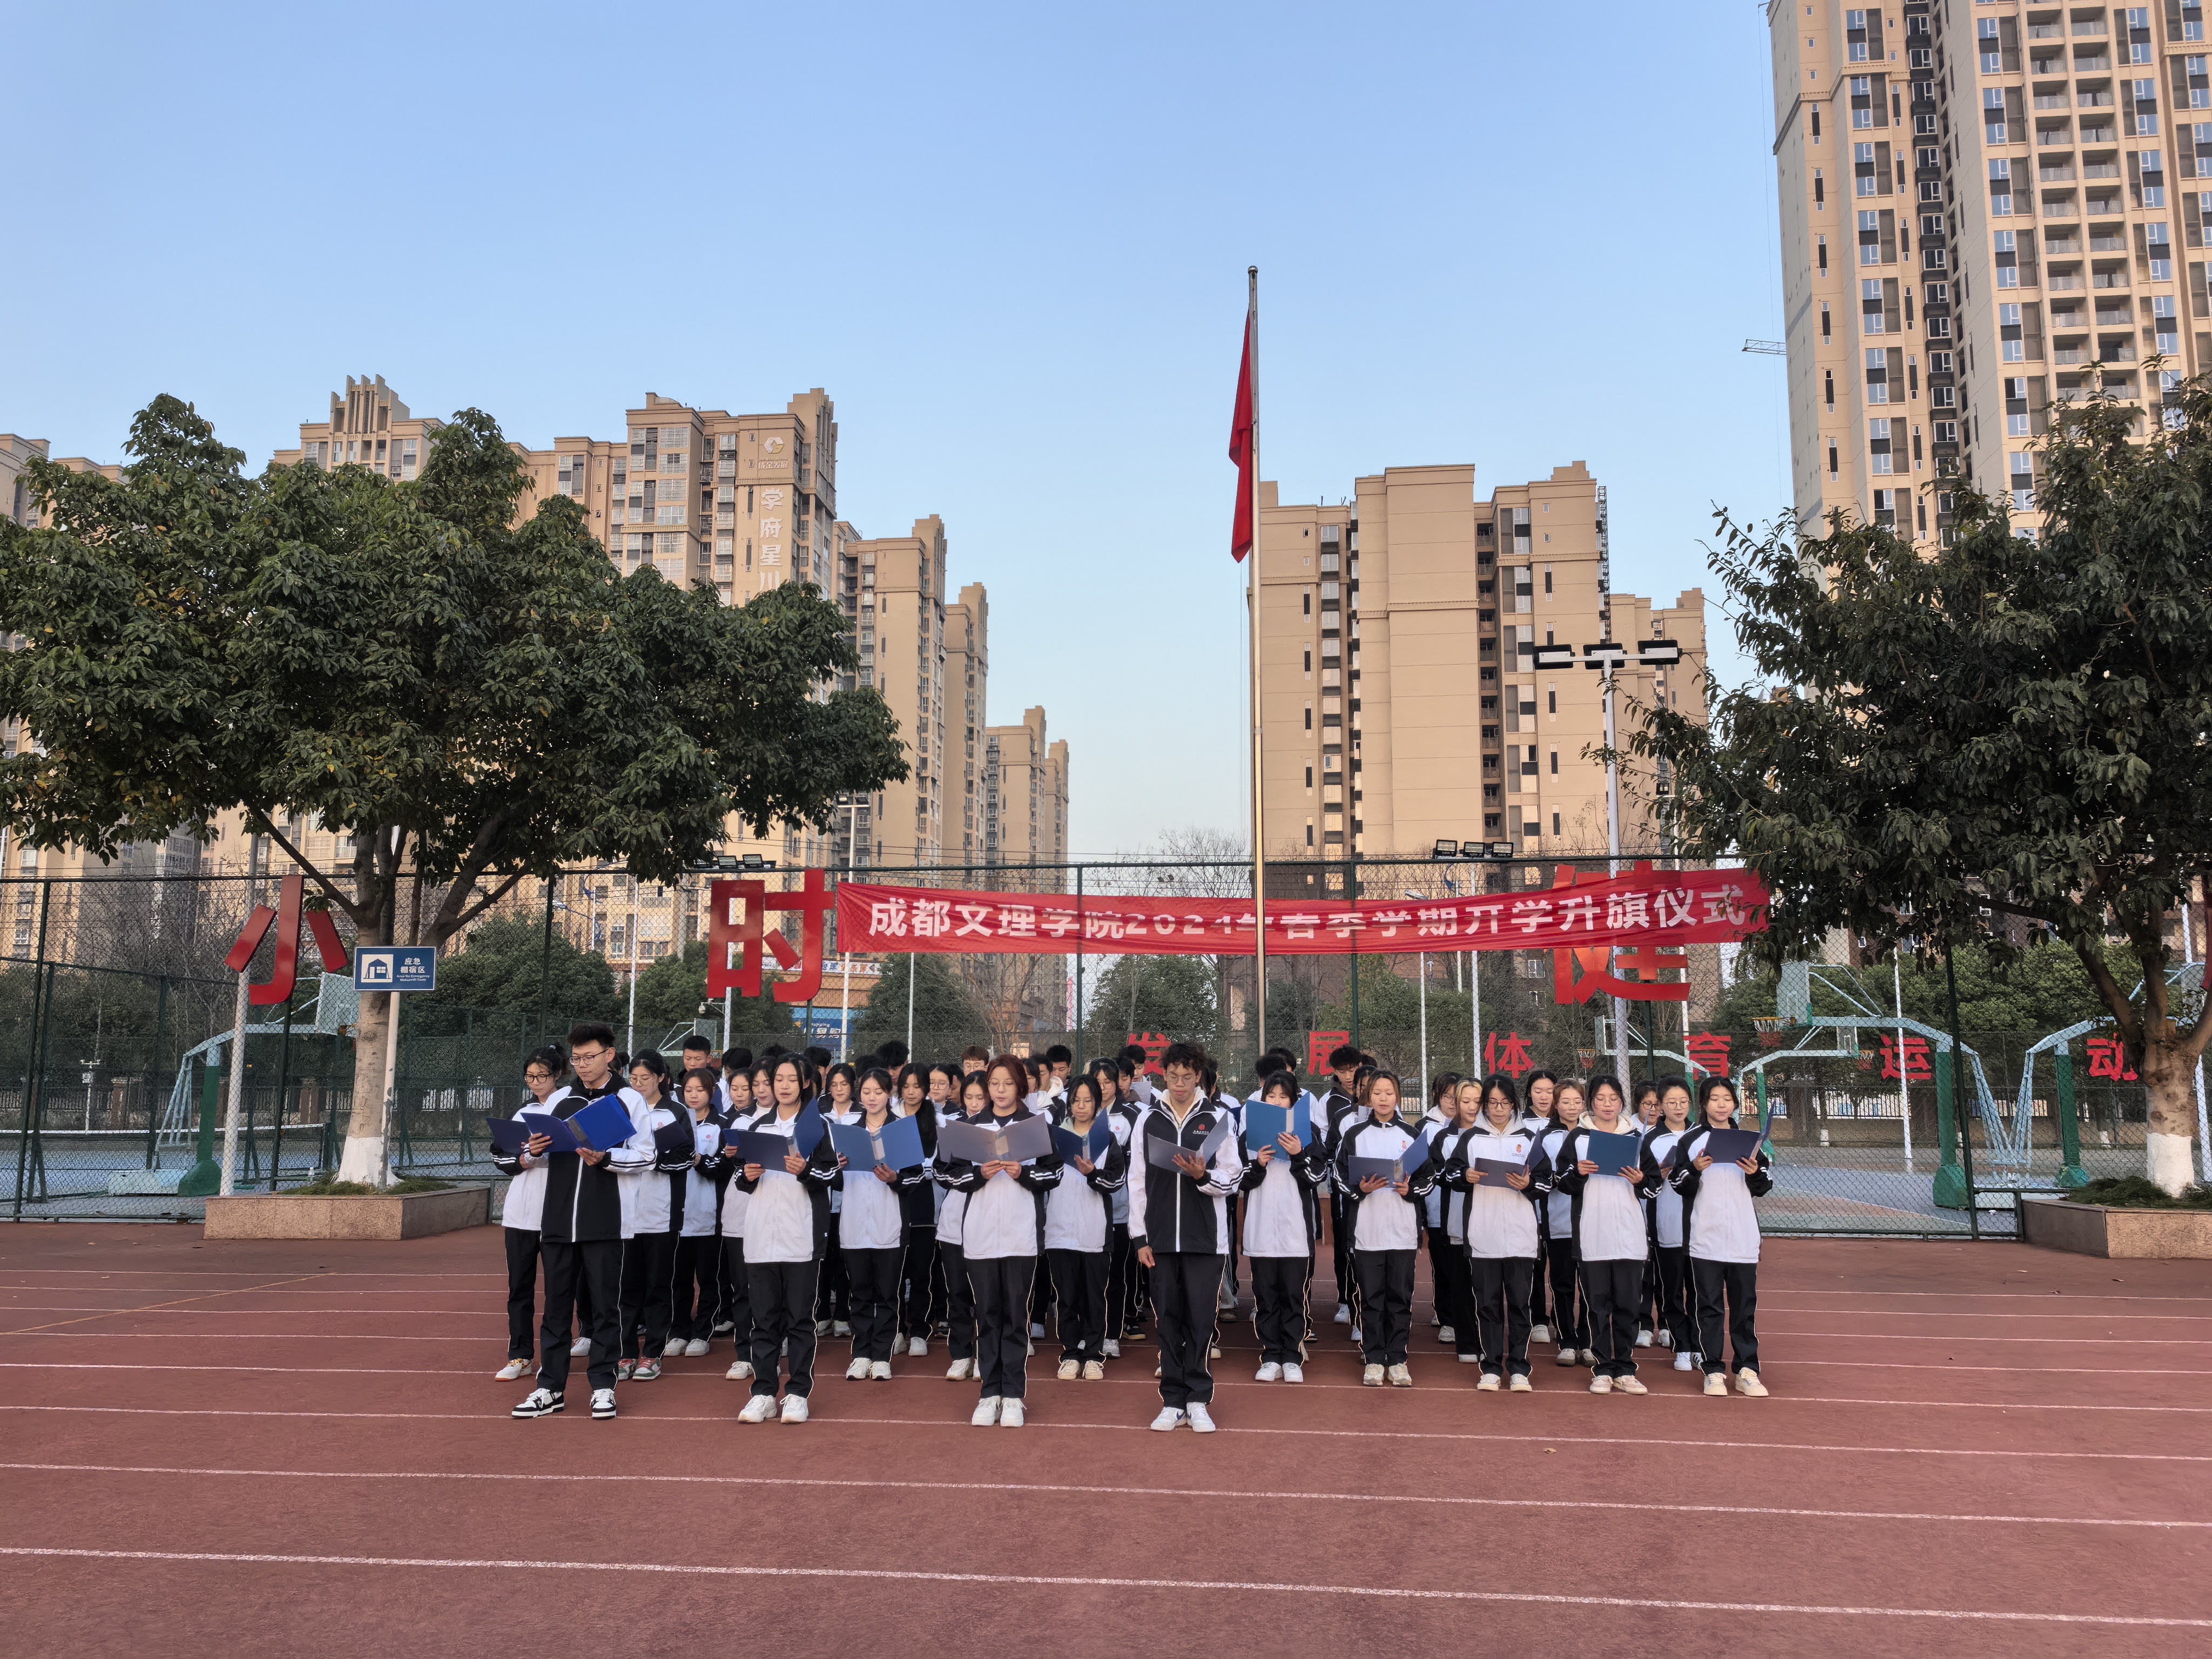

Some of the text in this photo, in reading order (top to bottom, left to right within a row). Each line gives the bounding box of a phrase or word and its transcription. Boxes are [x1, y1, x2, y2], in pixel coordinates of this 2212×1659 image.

[759, 488, 783, 592] 学府星川
[224, 875, 348, 1005] 小
[706, 868, 835, 1002] 时
[1484, 1032, 1534, 1079] 体
[1683, 1031, 1731, 1080] 育
[1880, 1034, 1932, 1079] 运
